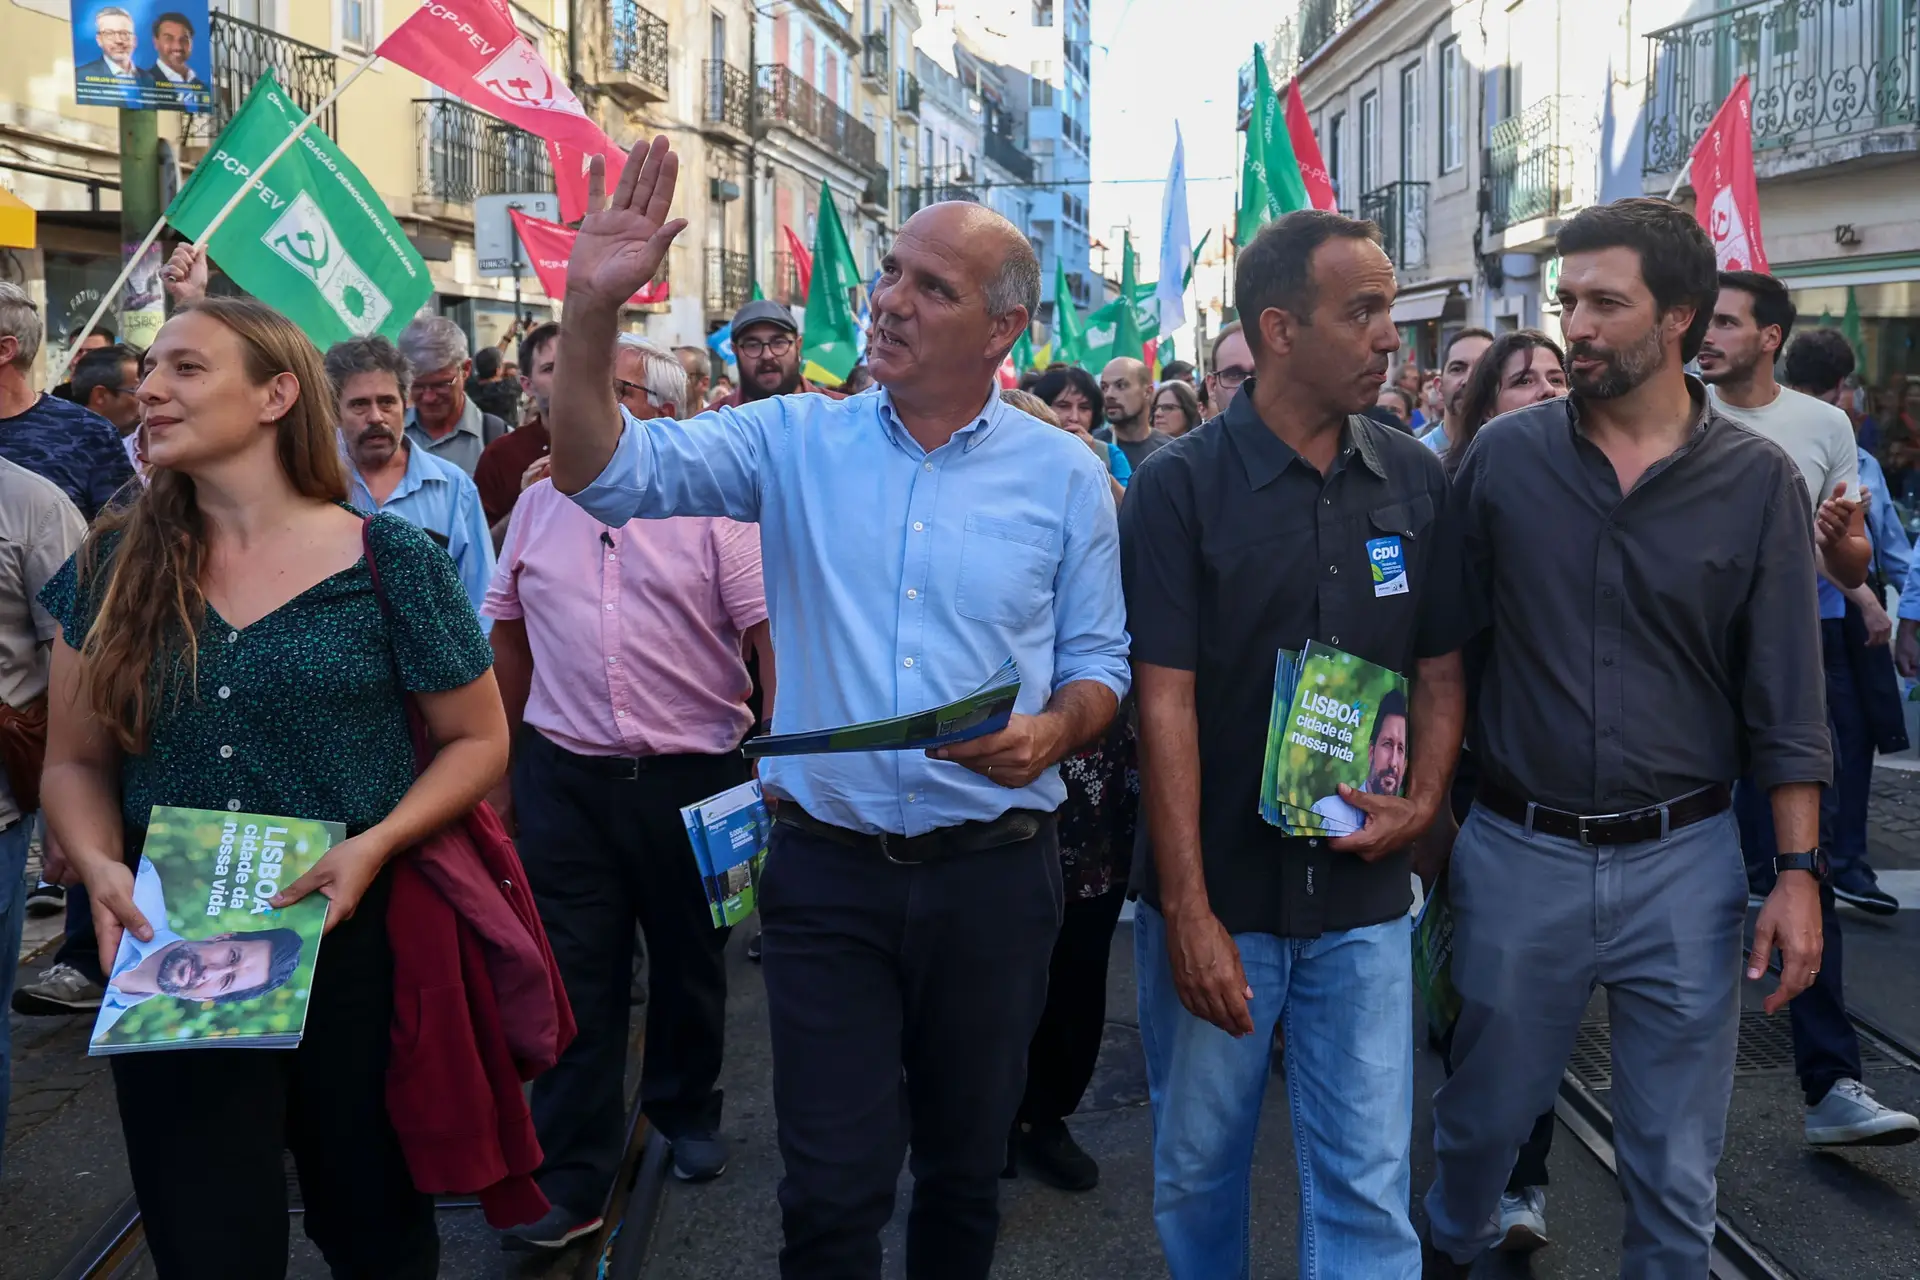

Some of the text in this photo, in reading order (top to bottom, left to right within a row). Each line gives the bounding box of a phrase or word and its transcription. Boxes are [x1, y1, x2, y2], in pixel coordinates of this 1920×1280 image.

[212, 149, 286, 210] PCP-PEV
[287, 120, 338, 173] CLIGAÇÃO
[334, 171, 388, 236] DEMOCRÁTICA
[385, 235, 417, 278] UNITÁRIA
[538, 259, 569, 269] PCP-P
[1372, 545, 1399, 561] CDU
[1296, 713, 1353, 744] cidade da
[1300, 690, 1361, 728] LISBOA
[1291, 731, 1354, 763] nossa vida
[206, 822, 238, 916] nossa vida
[229, 823, 261, 909] cidade da
[250, 826, 289, 915] LISBOA
